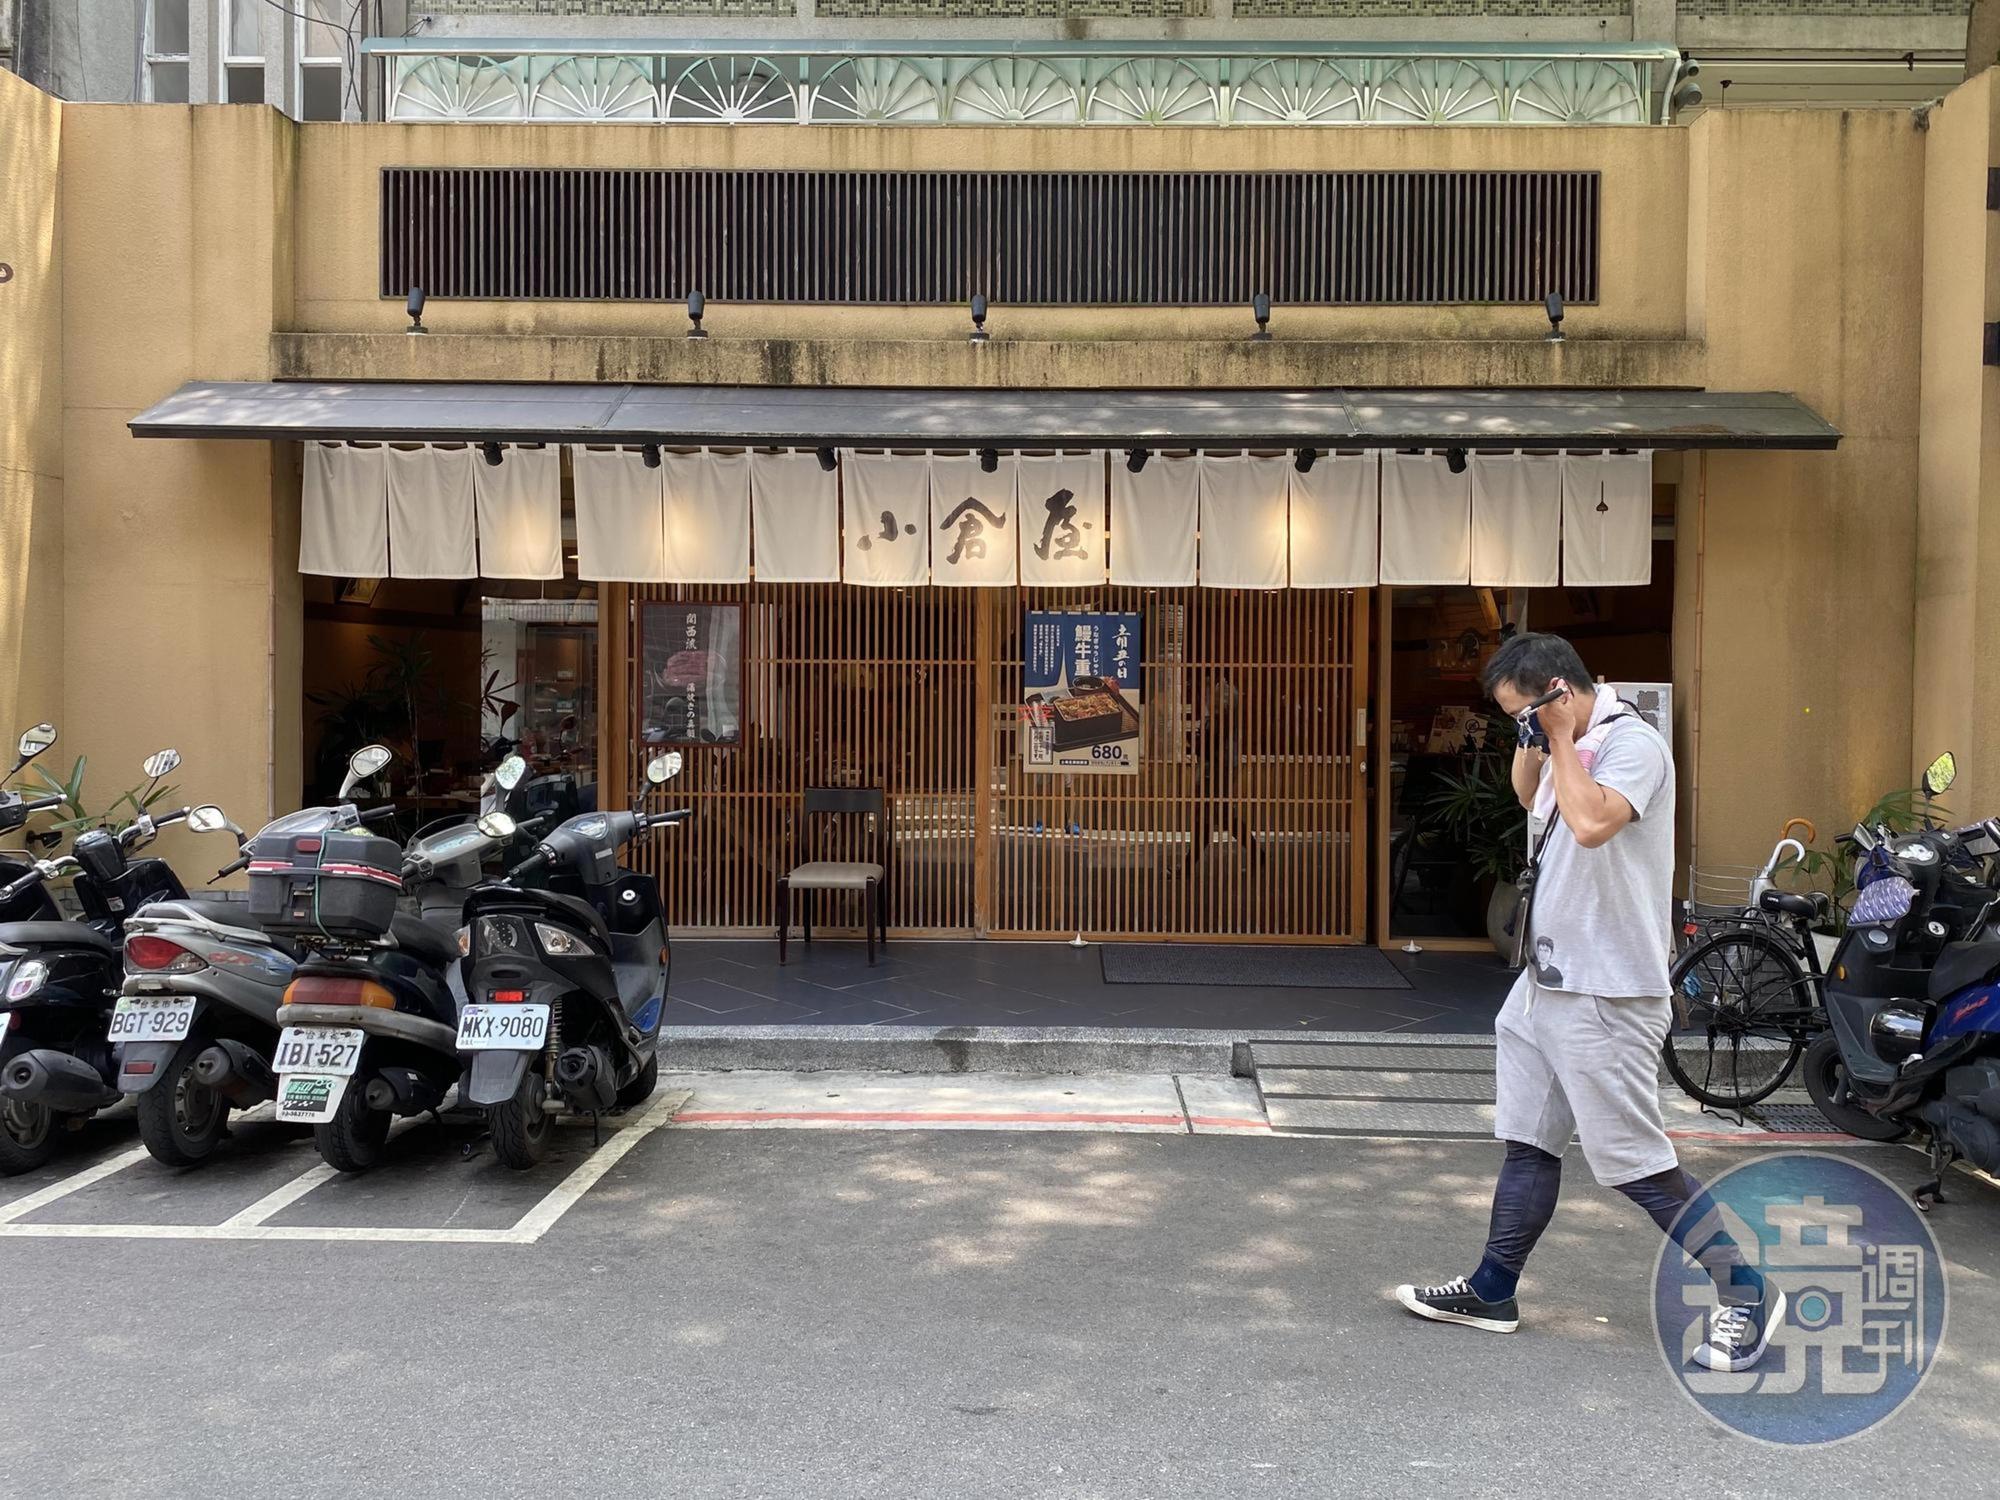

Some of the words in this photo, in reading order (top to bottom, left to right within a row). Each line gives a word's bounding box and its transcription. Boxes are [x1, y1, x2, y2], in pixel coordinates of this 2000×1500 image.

[857, 488, 1093, 566] 小倉屋
[1074, 624, 1092, 676] 鰻牛重
